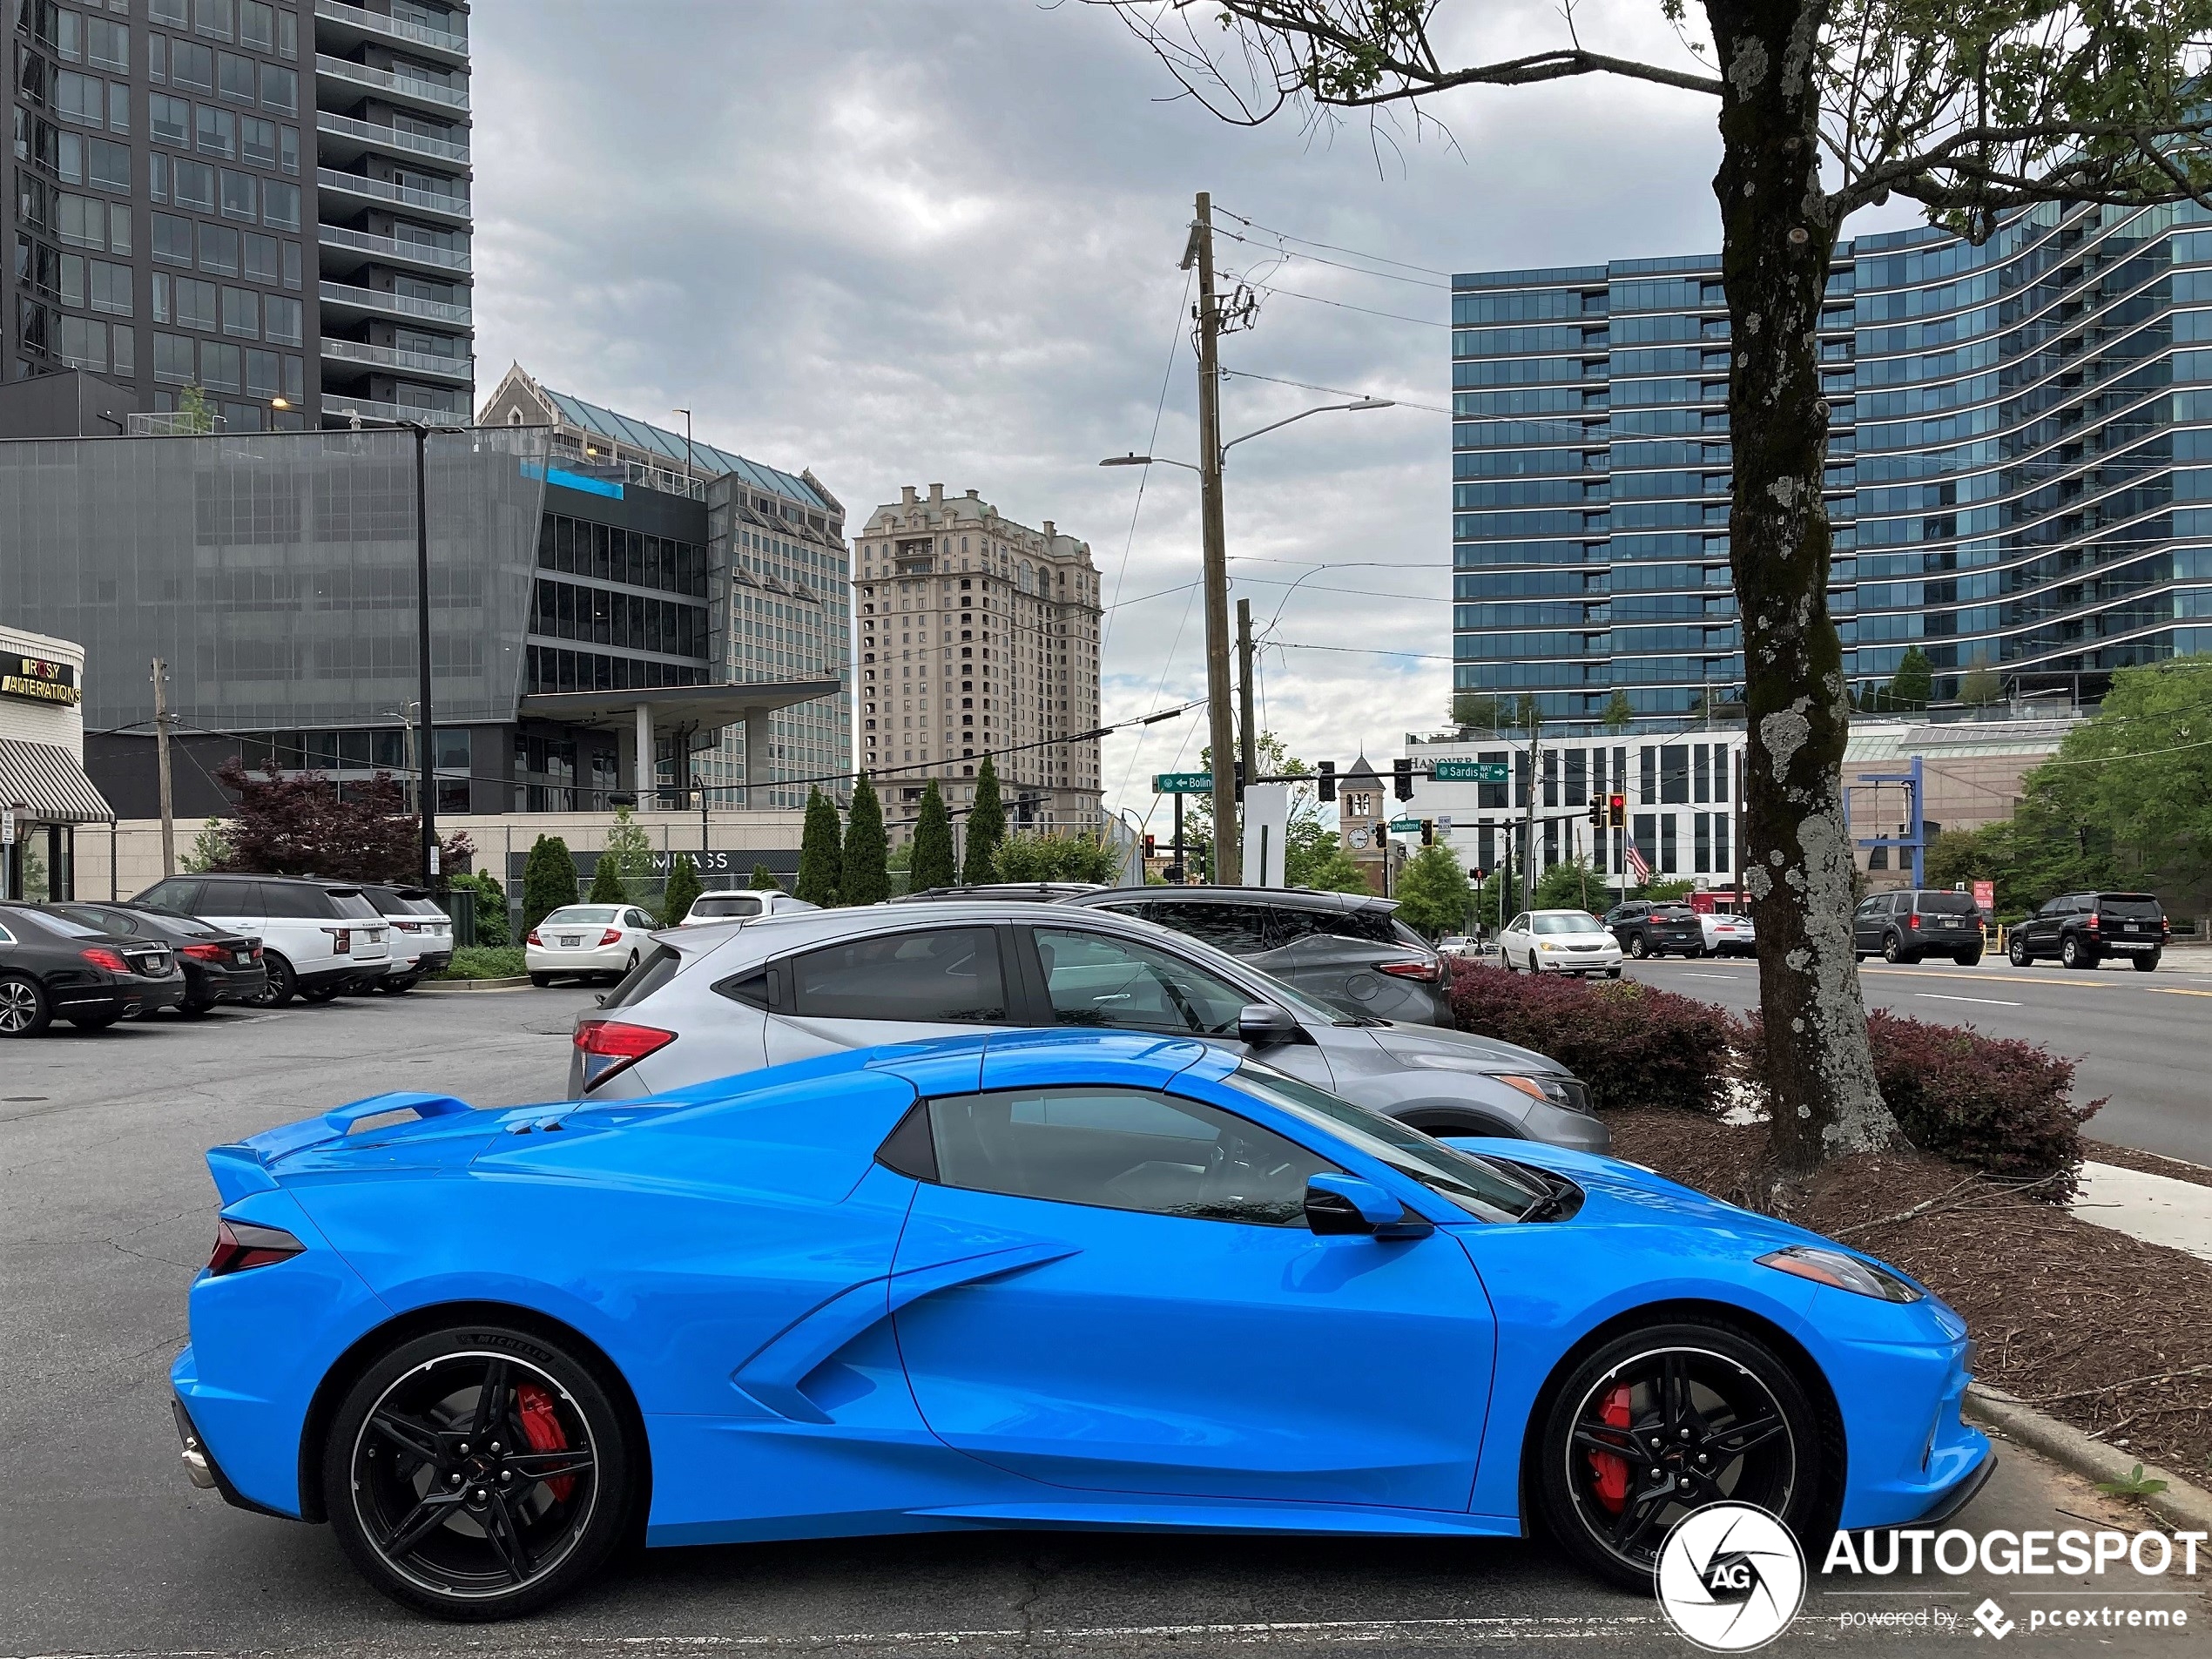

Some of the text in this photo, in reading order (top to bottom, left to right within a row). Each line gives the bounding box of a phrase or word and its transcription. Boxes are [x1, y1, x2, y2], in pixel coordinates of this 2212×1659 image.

[30, 659, 60, 678] ROSY
[10, 676, 82, 703] ALTERATIONS
[1450, 766, 1479, 777] Sardis
[1396, 822, 1419, 831] Peachtree
[478, 1334, 550, 1360] MICHELIN
